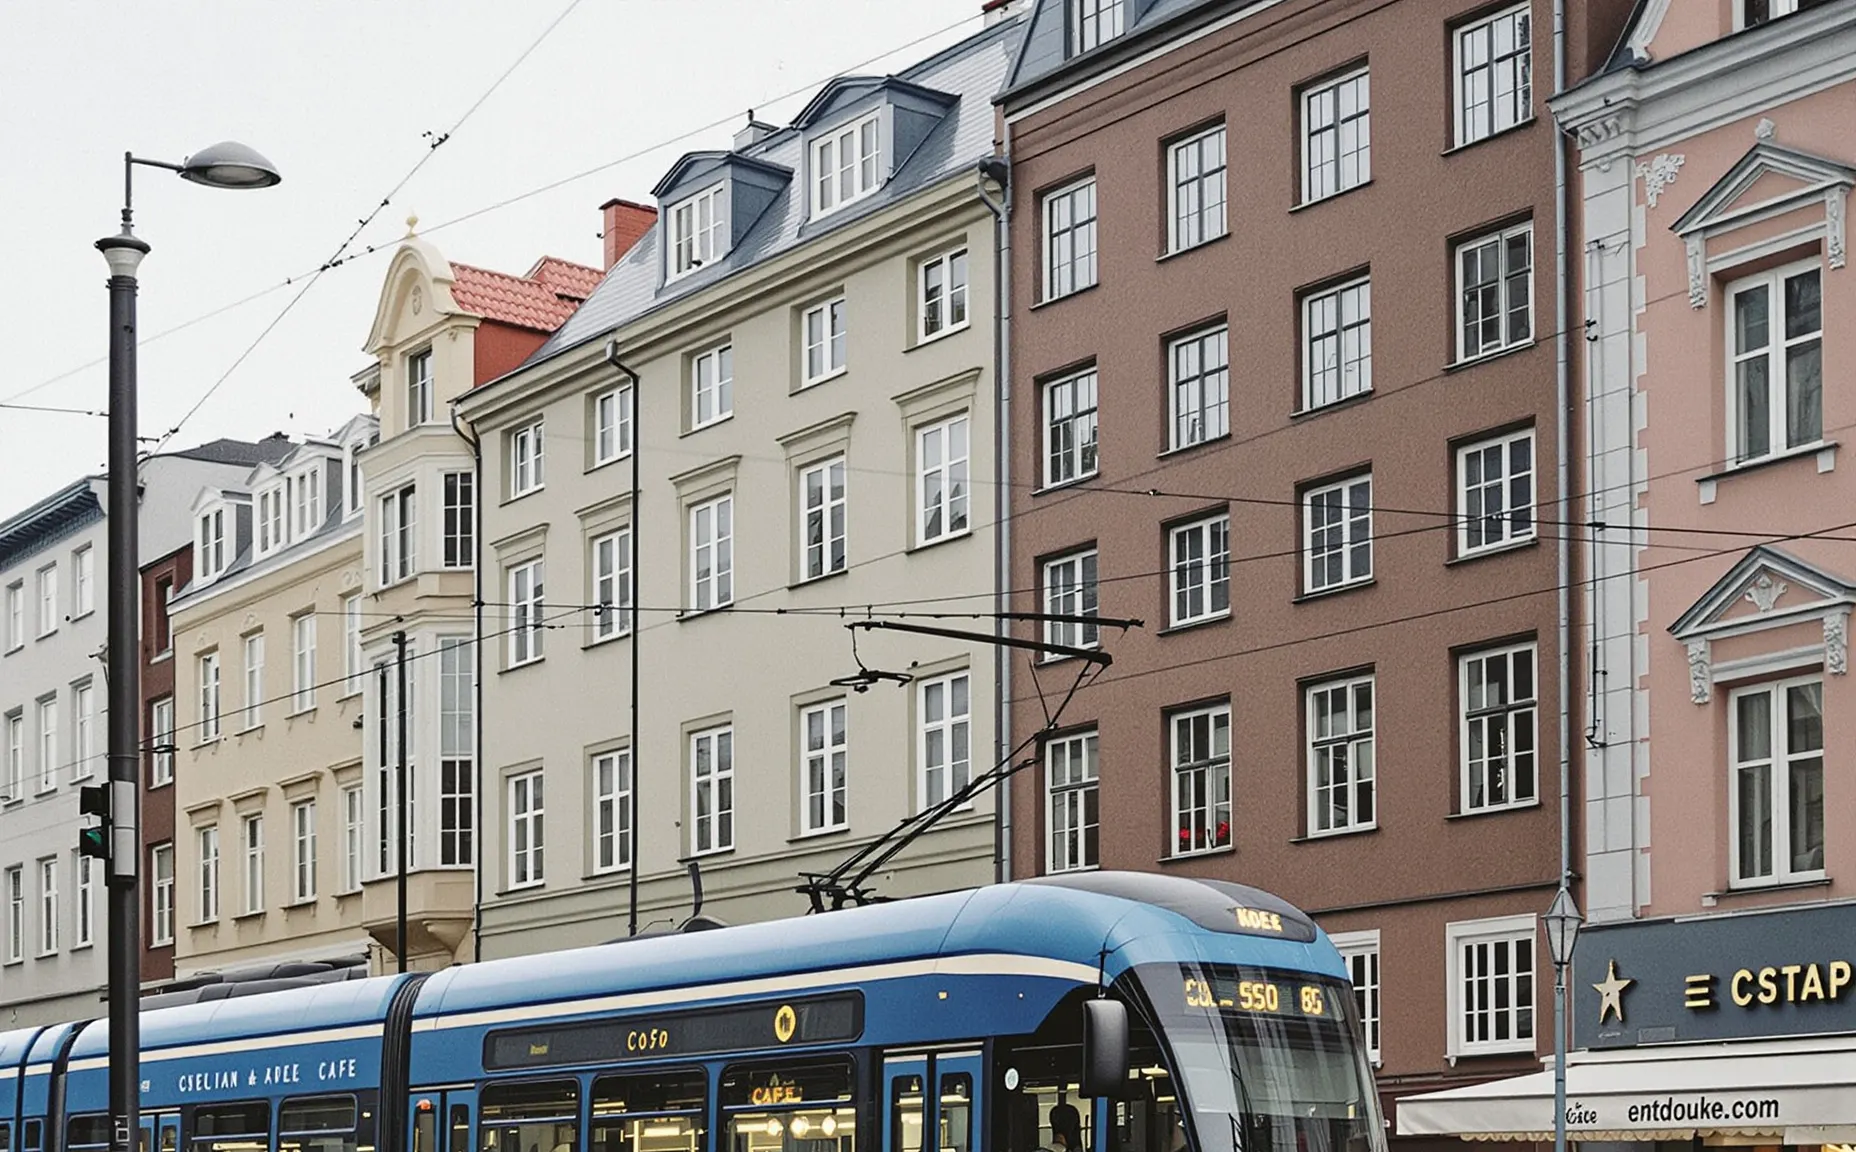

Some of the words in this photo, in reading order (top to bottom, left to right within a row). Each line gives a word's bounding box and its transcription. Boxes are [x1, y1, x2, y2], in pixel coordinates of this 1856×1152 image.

[1731, 960, 1851, 1007] CSTAP
[319, 1058, 357, 1081] CAFE
[1628, 1096, 1780, 1123] entdouke.com
